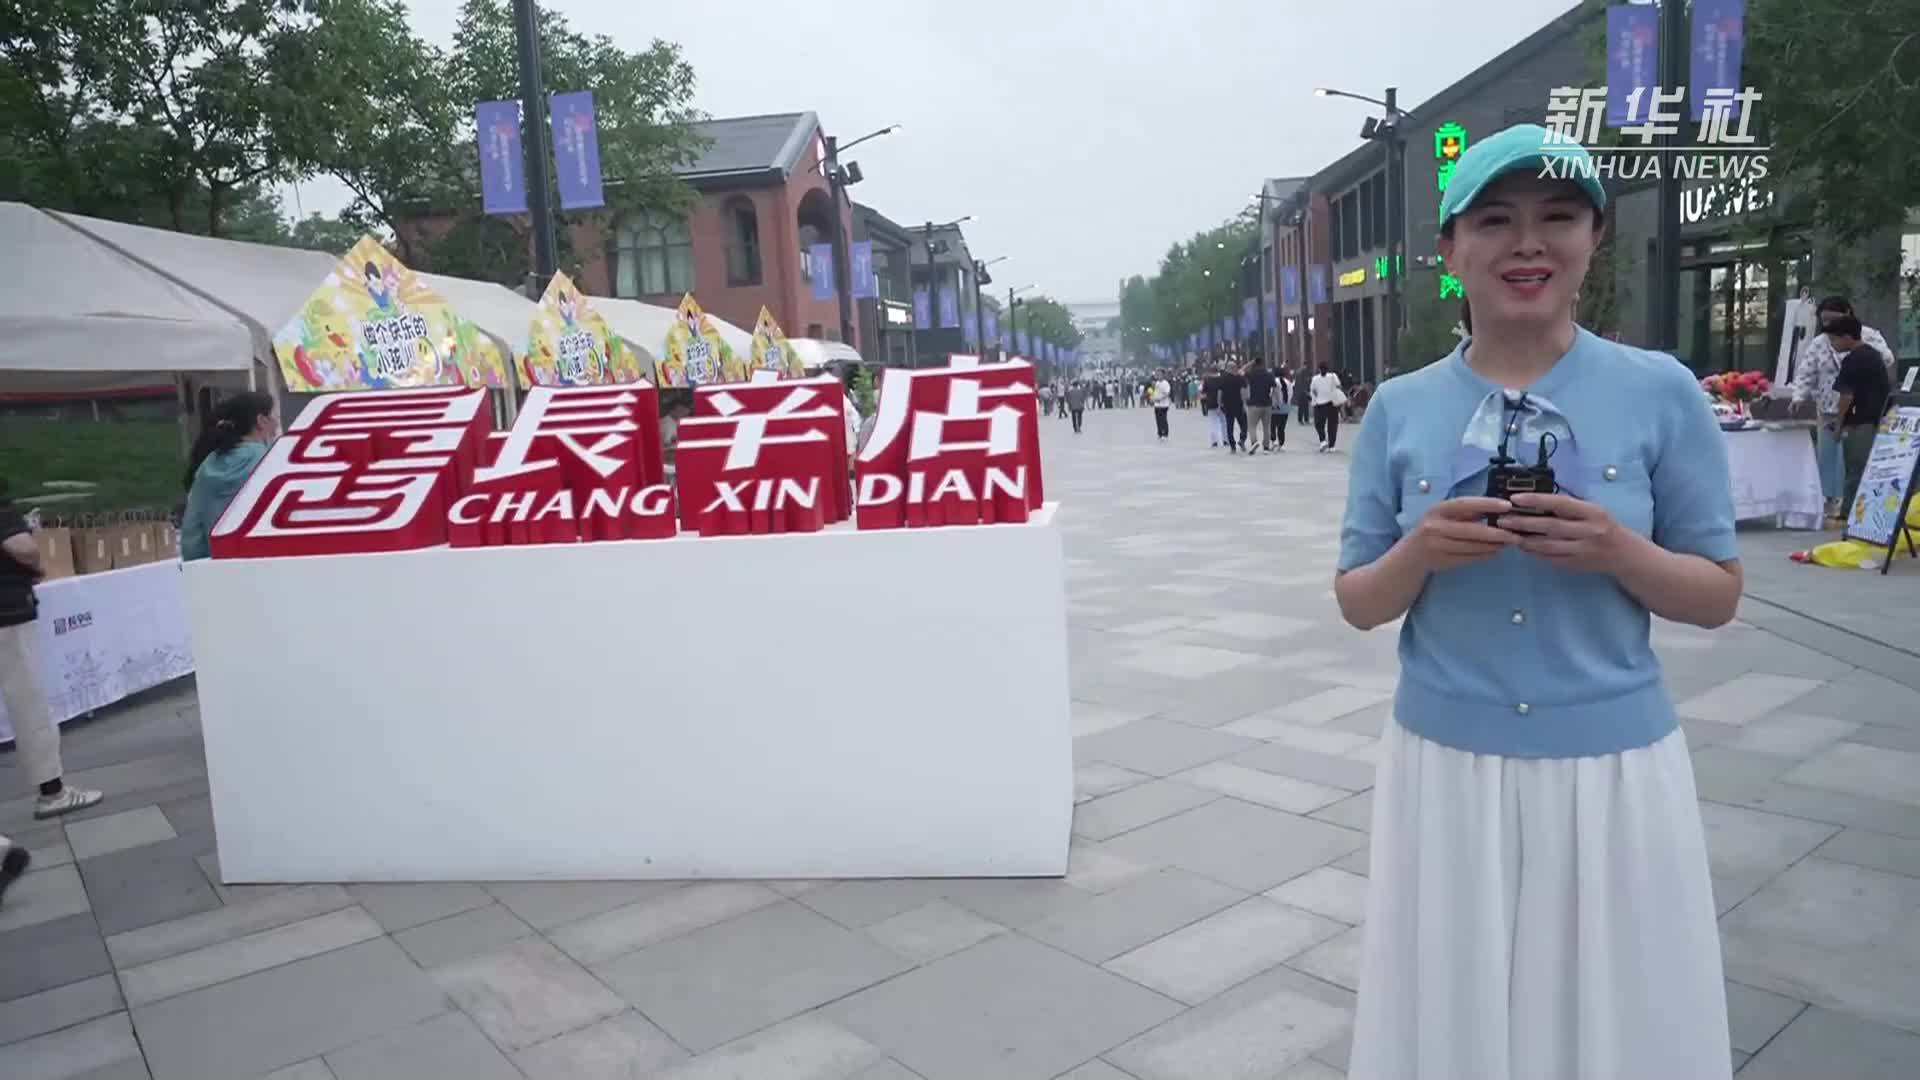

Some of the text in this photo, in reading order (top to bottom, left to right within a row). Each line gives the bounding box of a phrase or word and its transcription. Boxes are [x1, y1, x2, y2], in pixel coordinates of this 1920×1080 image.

[448, 465, 1027, 526] CHANG XIN DIAN
